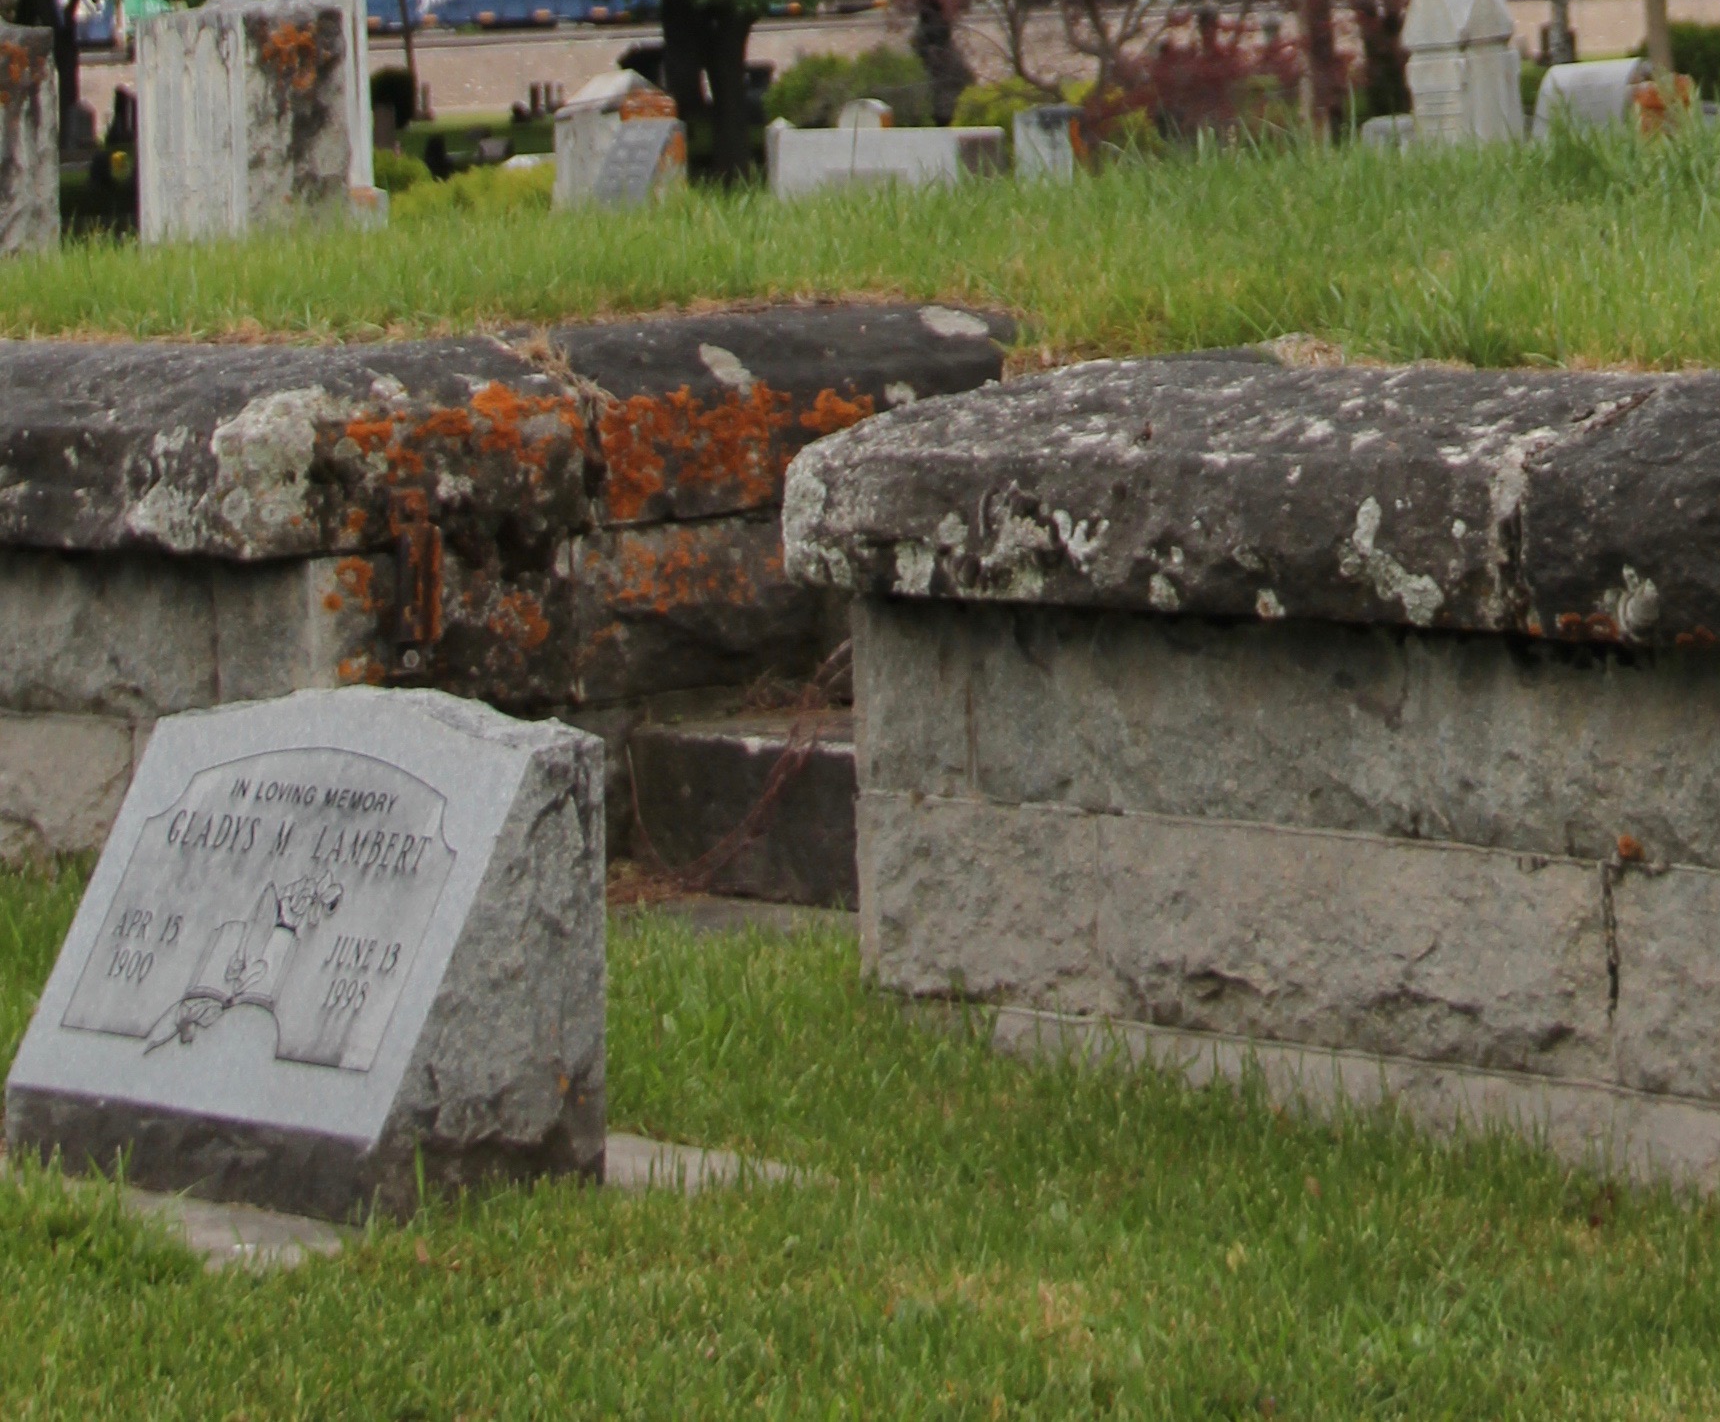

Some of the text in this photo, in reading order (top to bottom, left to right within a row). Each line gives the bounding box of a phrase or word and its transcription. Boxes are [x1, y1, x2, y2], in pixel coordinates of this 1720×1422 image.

[231, 778, 399, 814] IN LOVING MEMORY
[168, 809, 260, 854] GLADYS
[311, 825, 433, 876] LAMBERT
[107, 948, 154, 983] 1900
[323, 935, 378, 972] JUNE
[321, 978, 370, 1014] 1998
